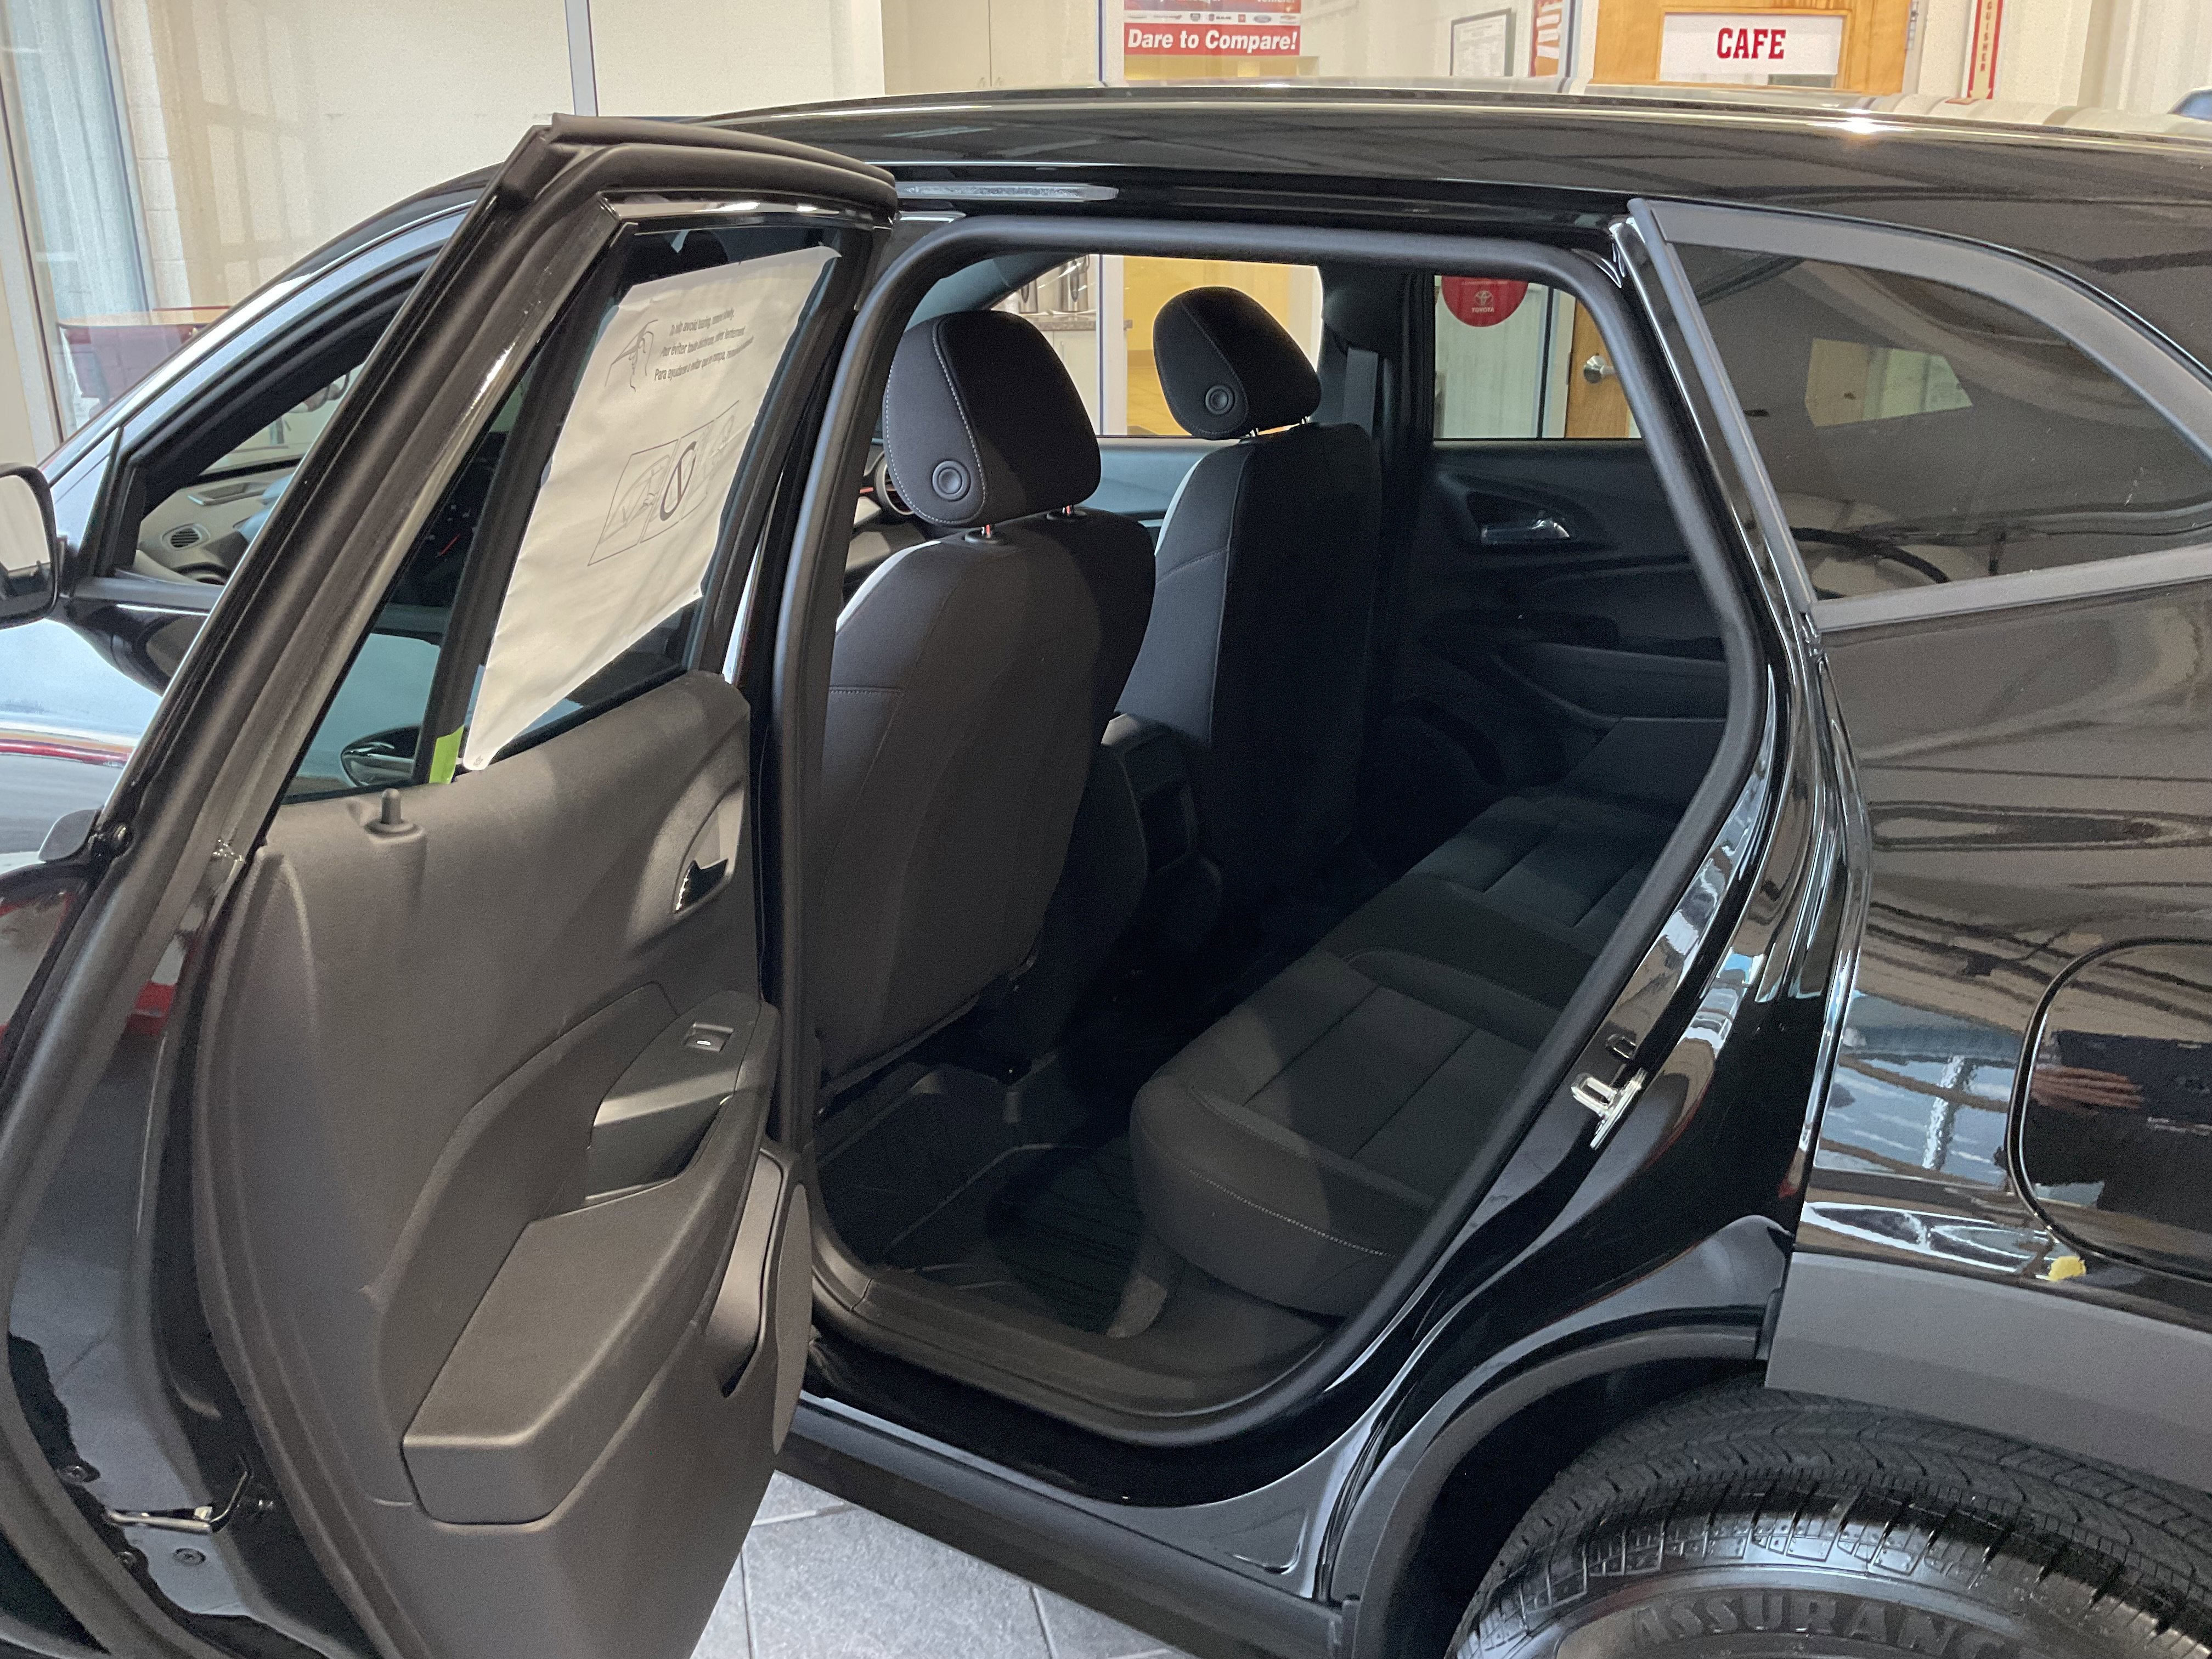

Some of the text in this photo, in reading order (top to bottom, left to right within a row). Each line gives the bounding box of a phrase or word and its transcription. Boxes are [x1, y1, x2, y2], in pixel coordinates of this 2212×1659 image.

[1127, 29, 1297, 53] Dare to Compare!
[1717, 27, 1786, 59] CAFE
[654, 368, 667, 381] Para
